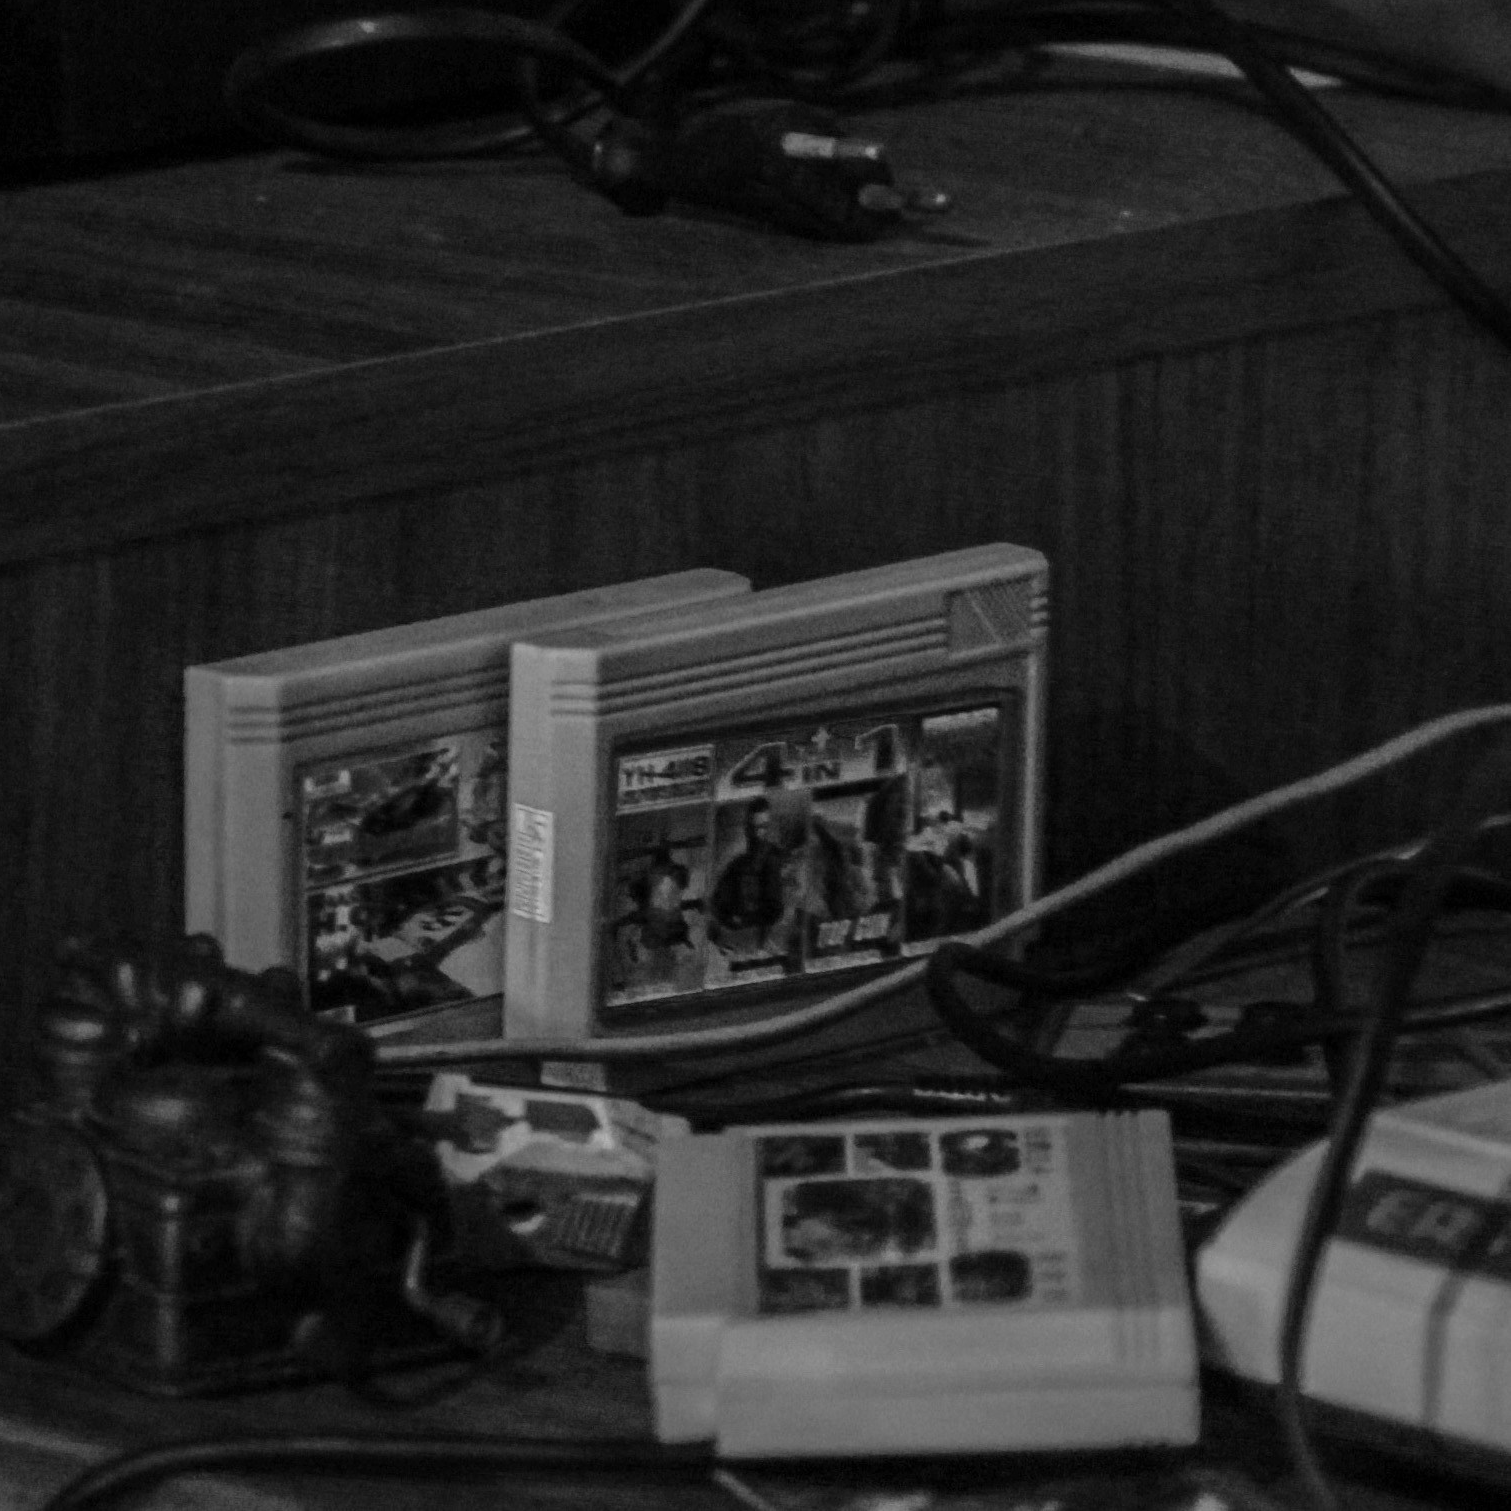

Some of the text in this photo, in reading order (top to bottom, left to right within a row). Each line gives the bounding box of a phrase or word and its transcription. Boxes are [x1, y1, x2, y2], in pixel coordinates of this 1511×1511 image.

[729, 723, 898, 788] 4 IN 1
